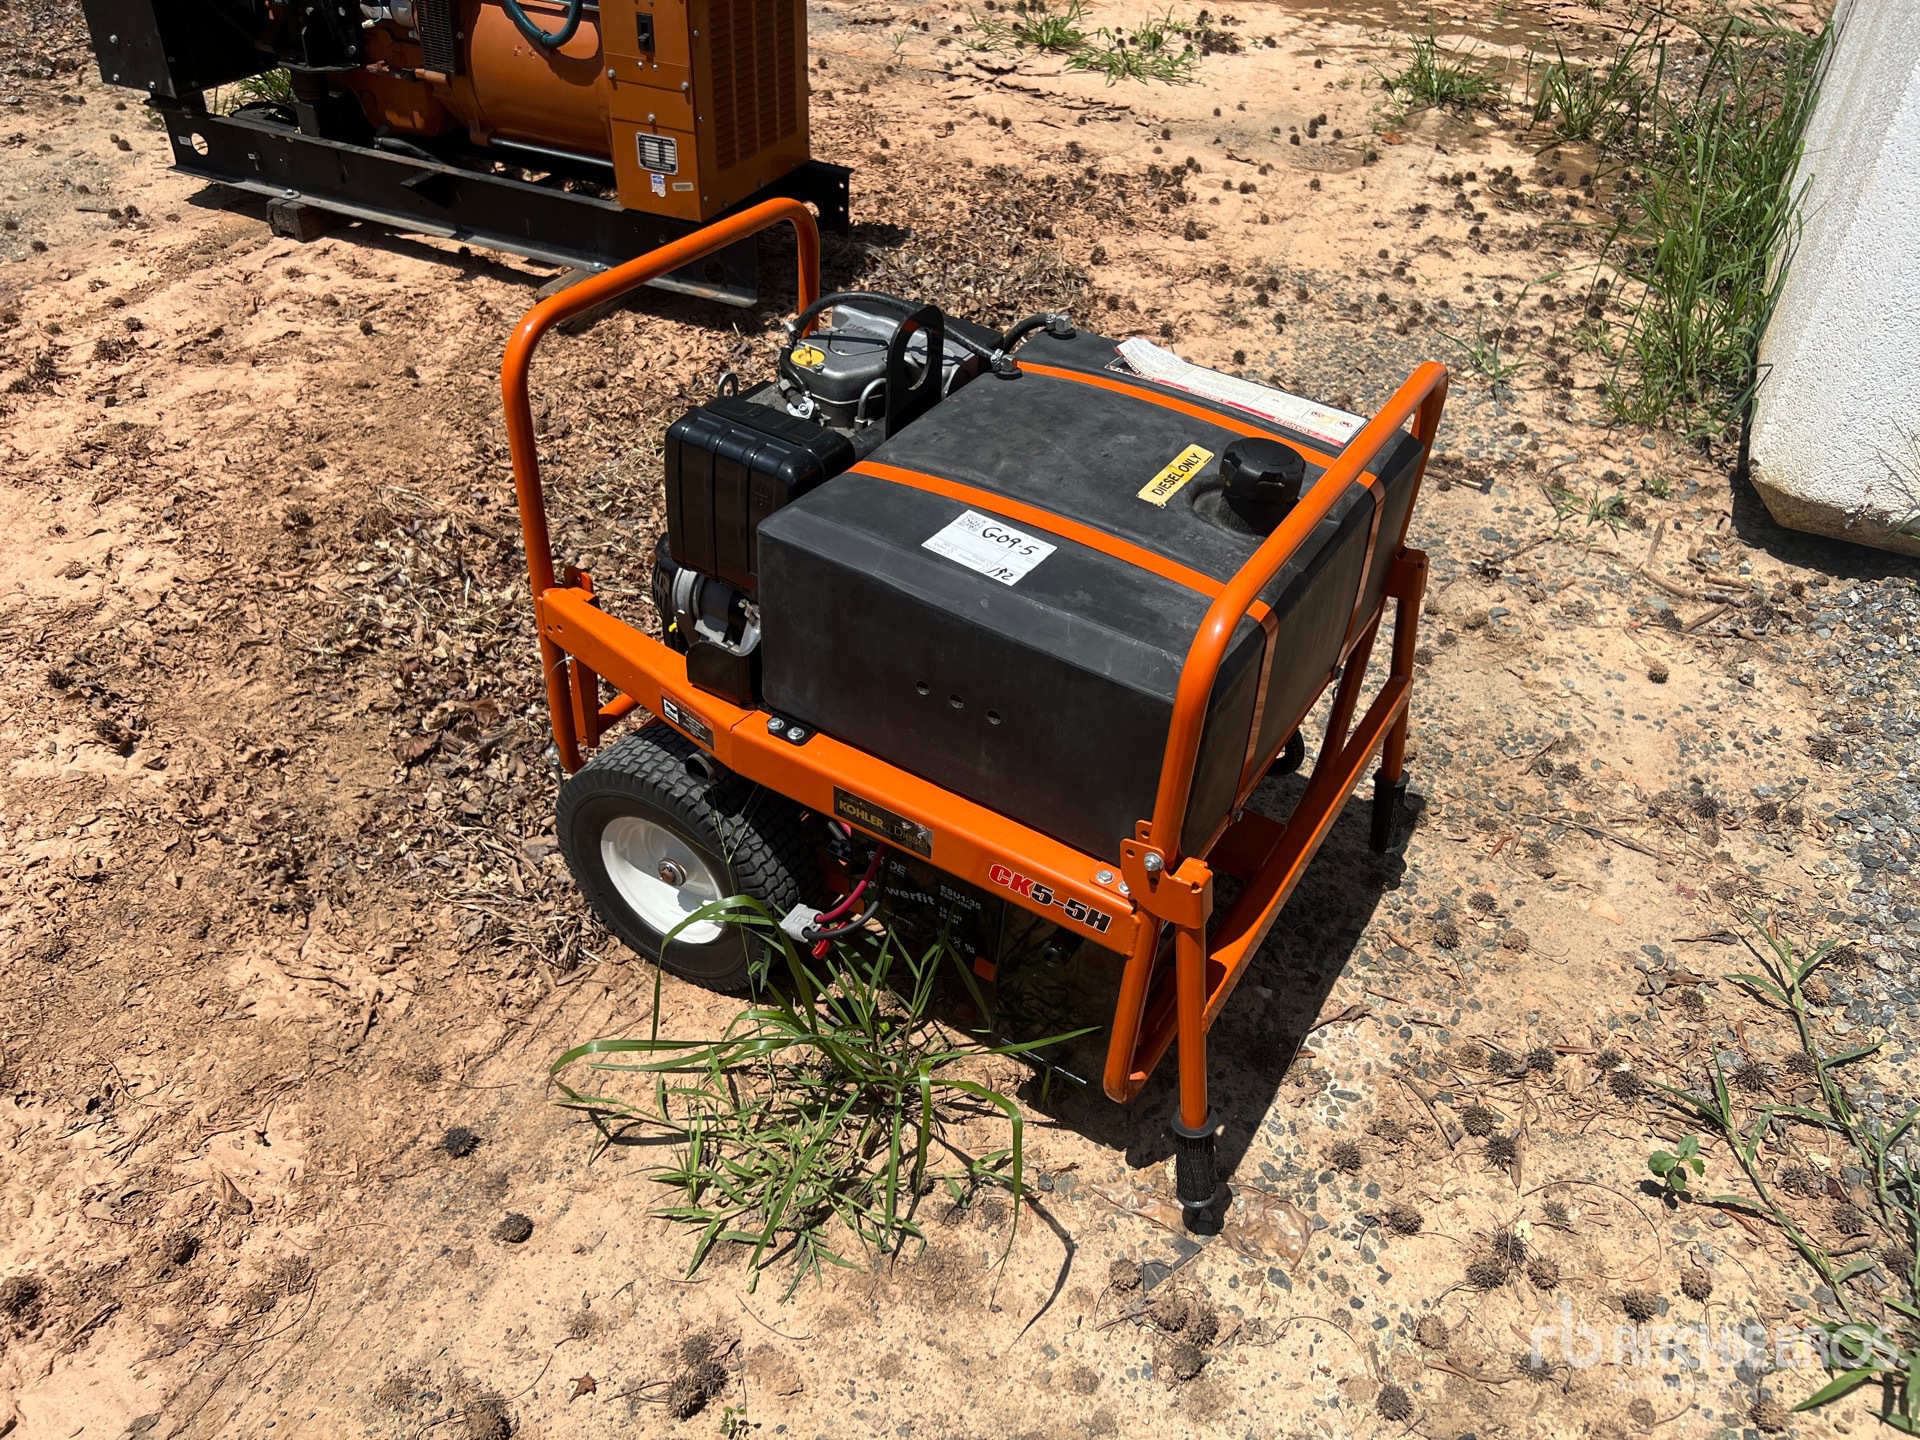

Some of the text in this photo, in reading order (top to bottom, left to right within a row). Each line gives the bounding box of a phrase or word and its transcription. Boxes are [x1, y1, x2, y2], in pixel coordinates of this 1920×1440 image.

[1151, 452, 1202, 496] DIESEL ONLY
[839, 800, 928, 849] KOHLER Diesel
[868, 880, 936, 905] Pwerfit
[940, 884, 982, 910] ESU1-35
[988, 864, 1113, 934] CK5-5H
